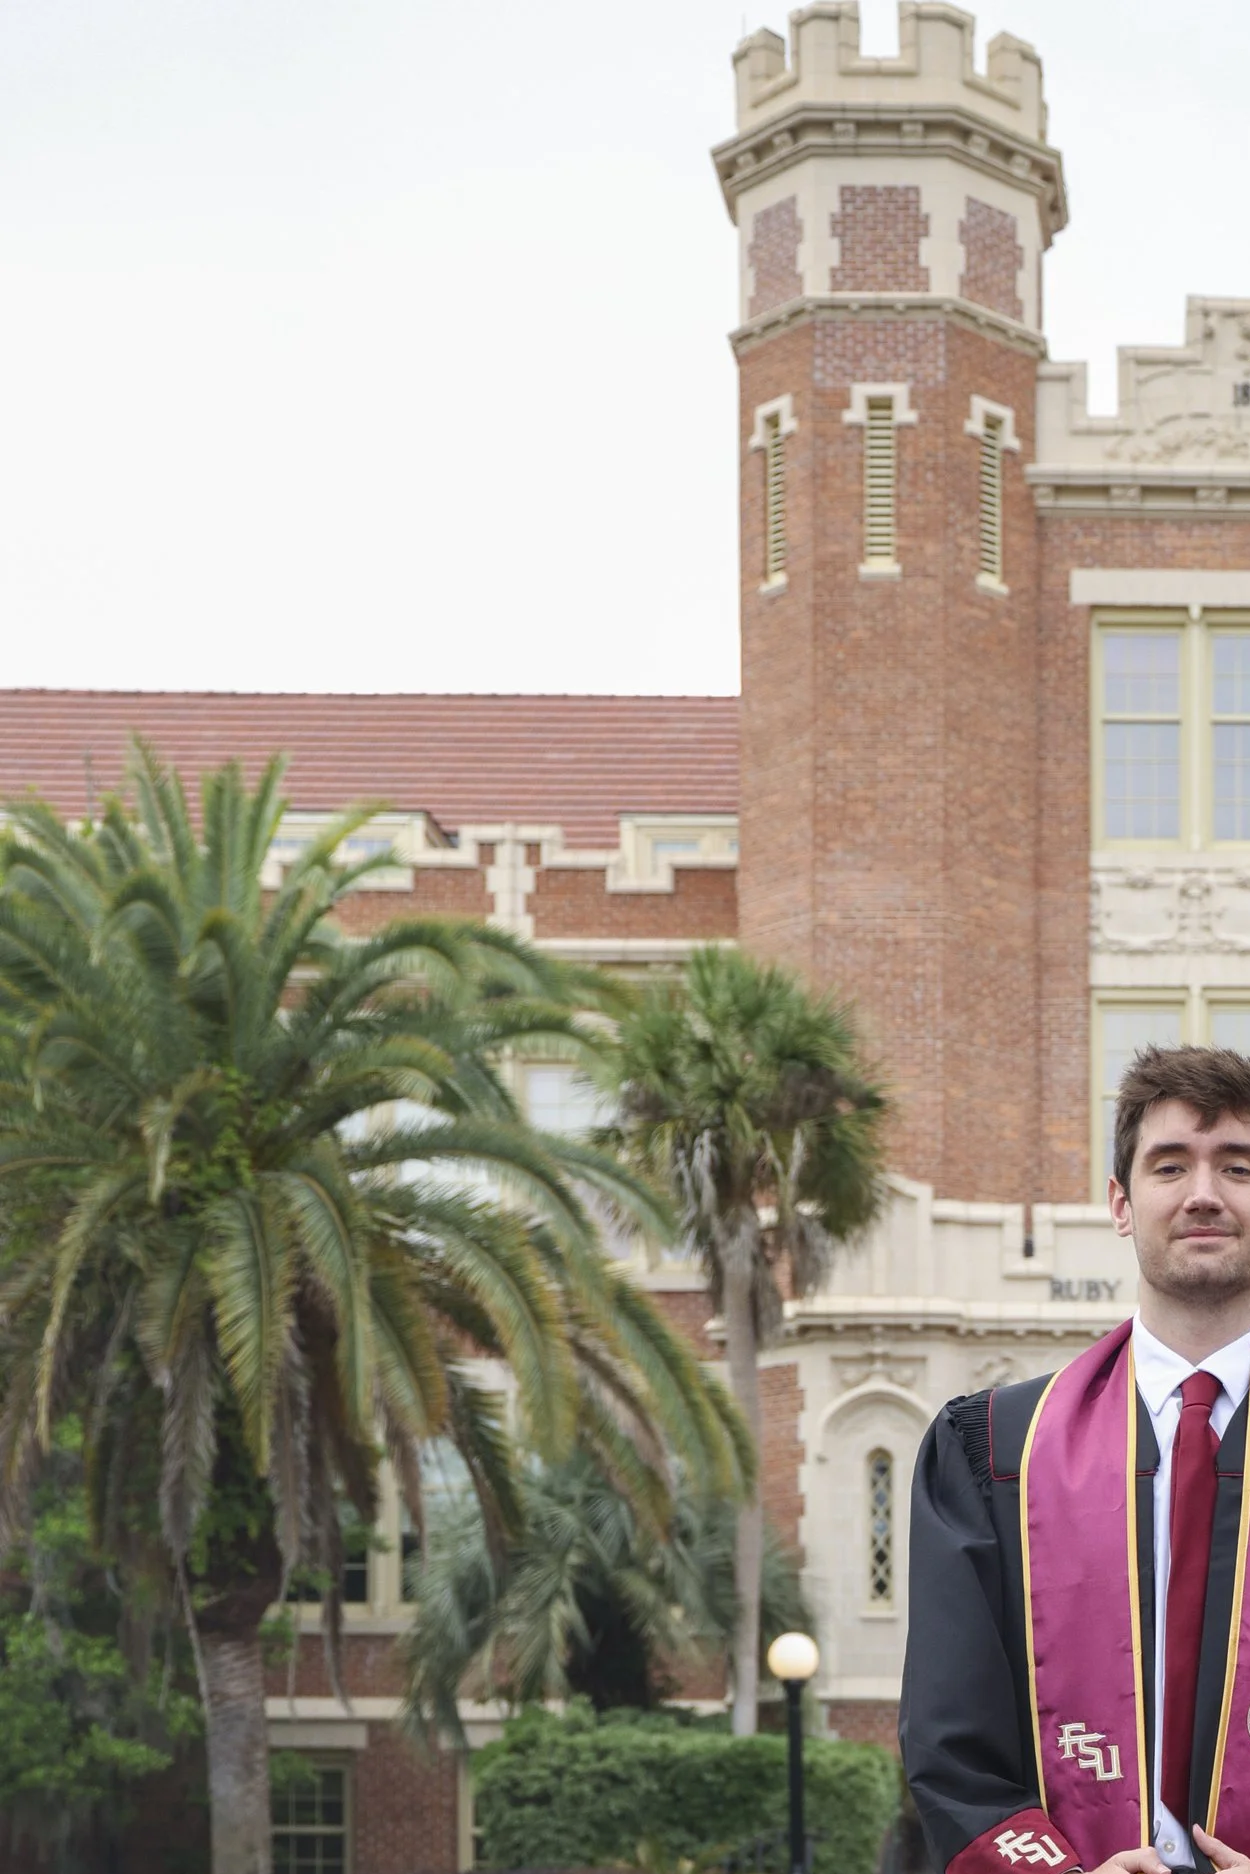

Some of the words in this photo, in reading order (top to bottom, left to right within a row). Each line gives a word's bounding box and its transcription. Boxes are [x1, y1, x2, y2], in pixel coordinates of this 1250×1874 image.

[1050, 1279, 1121, 1301] RUBY
[1056, 1722, 1124, 1781] FSU
[993, 1829, 1068, 1867] FSU
